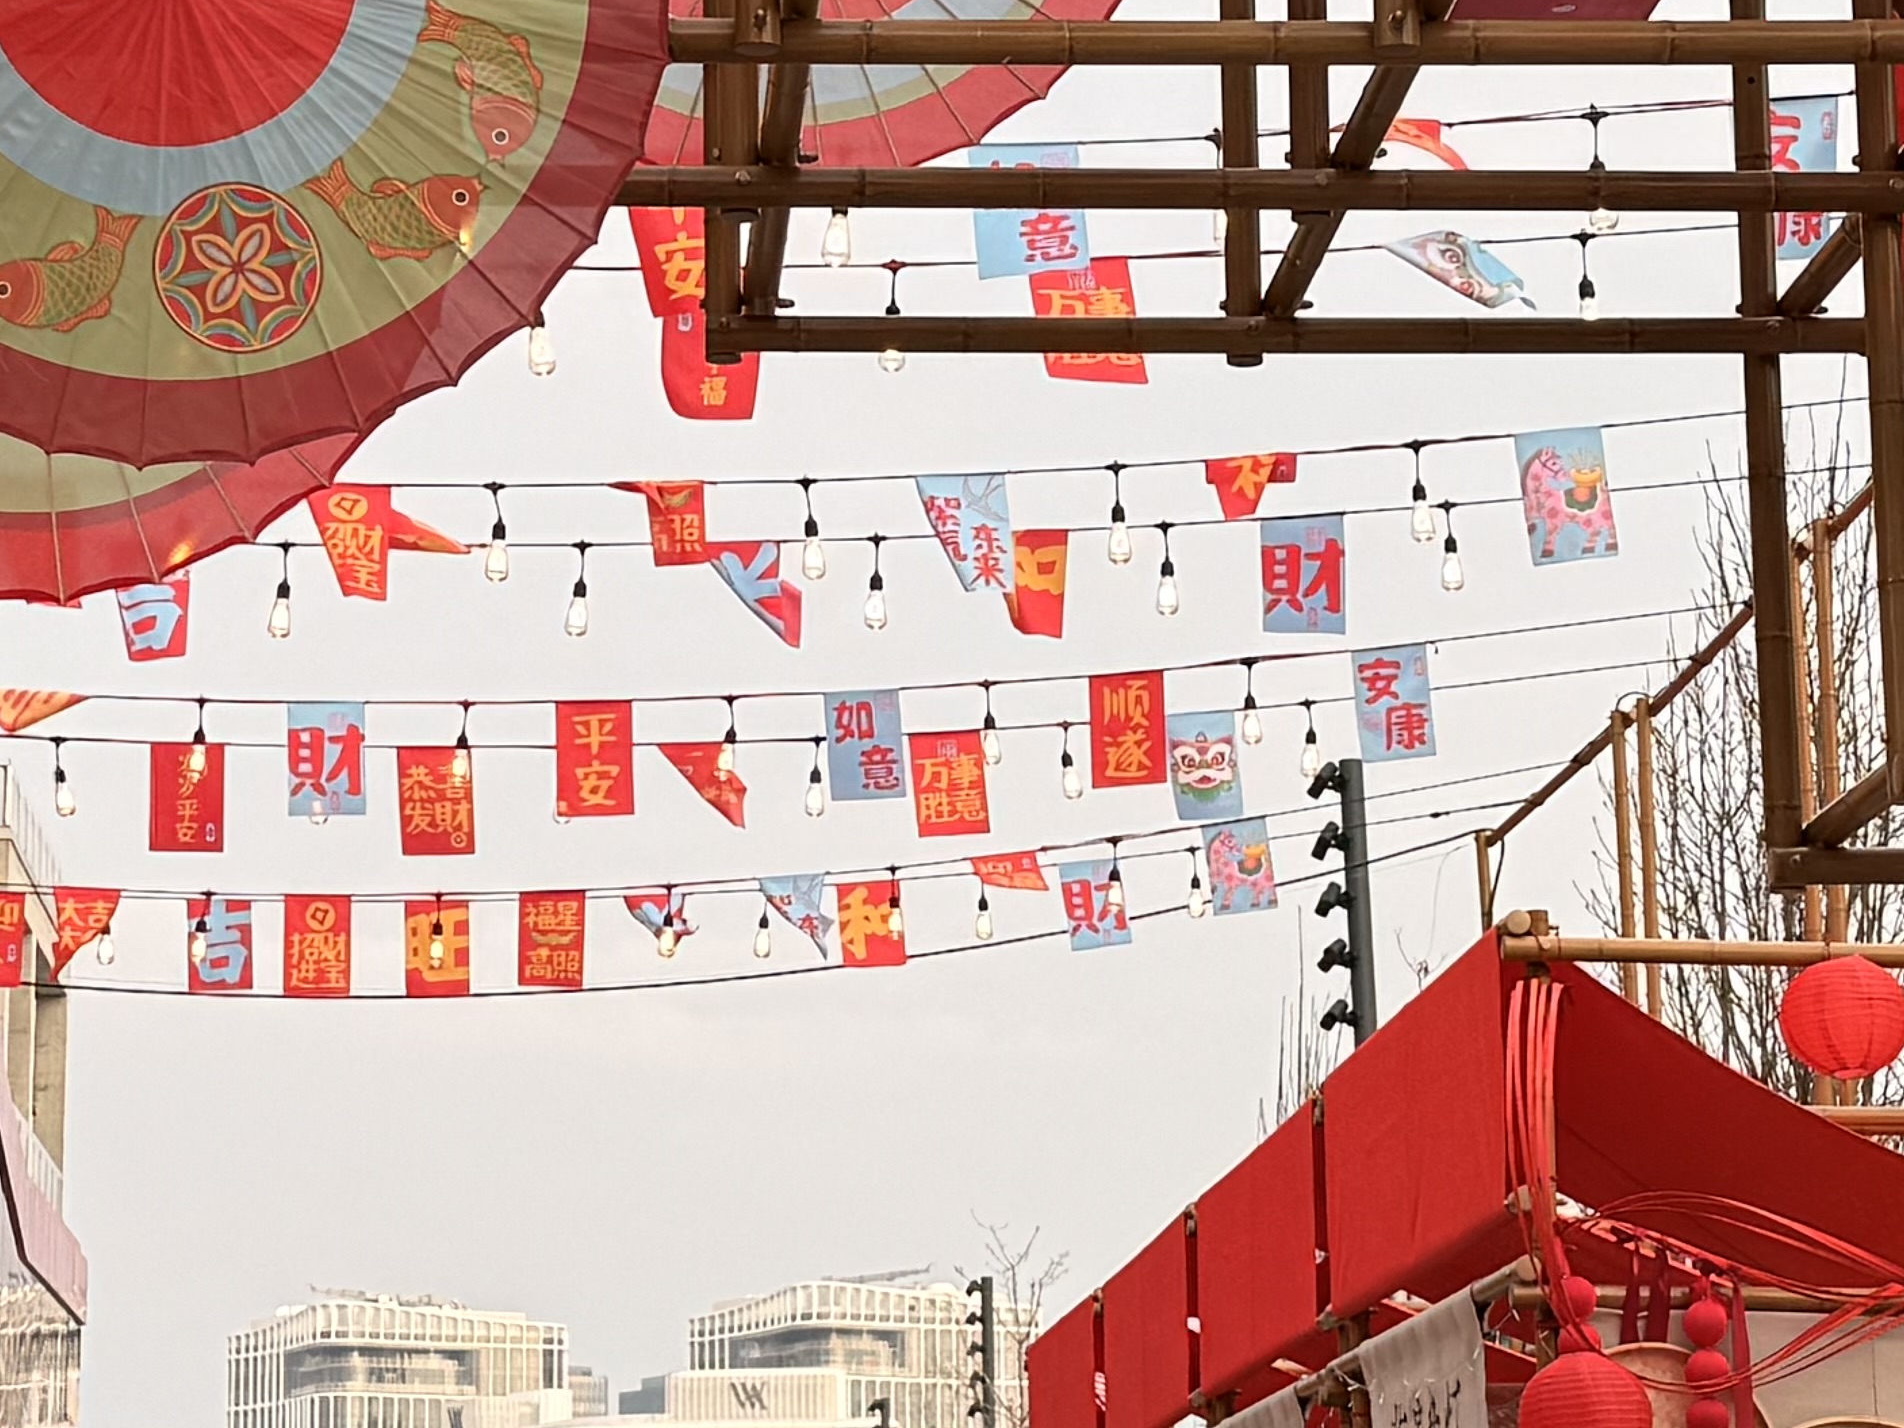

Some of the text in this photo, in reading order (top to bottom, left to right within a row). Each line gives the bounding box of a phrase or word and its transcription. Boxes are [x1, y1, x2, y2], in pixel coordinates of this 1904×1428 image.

[971, 523, 1007, 590] 东来
[1262, 537, 1345, 615] 財
[1100, 678, 1152, 779] 顺遂
[1357, 655, 1429, 752] 安康
[288, 724, 365, 798] 財
[570, 712, 623, 808] 平安
[831, 696, 902, 791] 如意
[920, 752, 981, 791] 万事
[918, 791, 987, 824] 胜意
[59, 898, 110, 928] 大吉
[196, 899, 251, 987] 吉
[290, 933, 348, 962] 招财
[407, 908, 470, 983] 旺
[523, 900, 581, 931] 福星
[290, 960, 348, 990] 进宝
[523, 948, 582, 981] 高照
